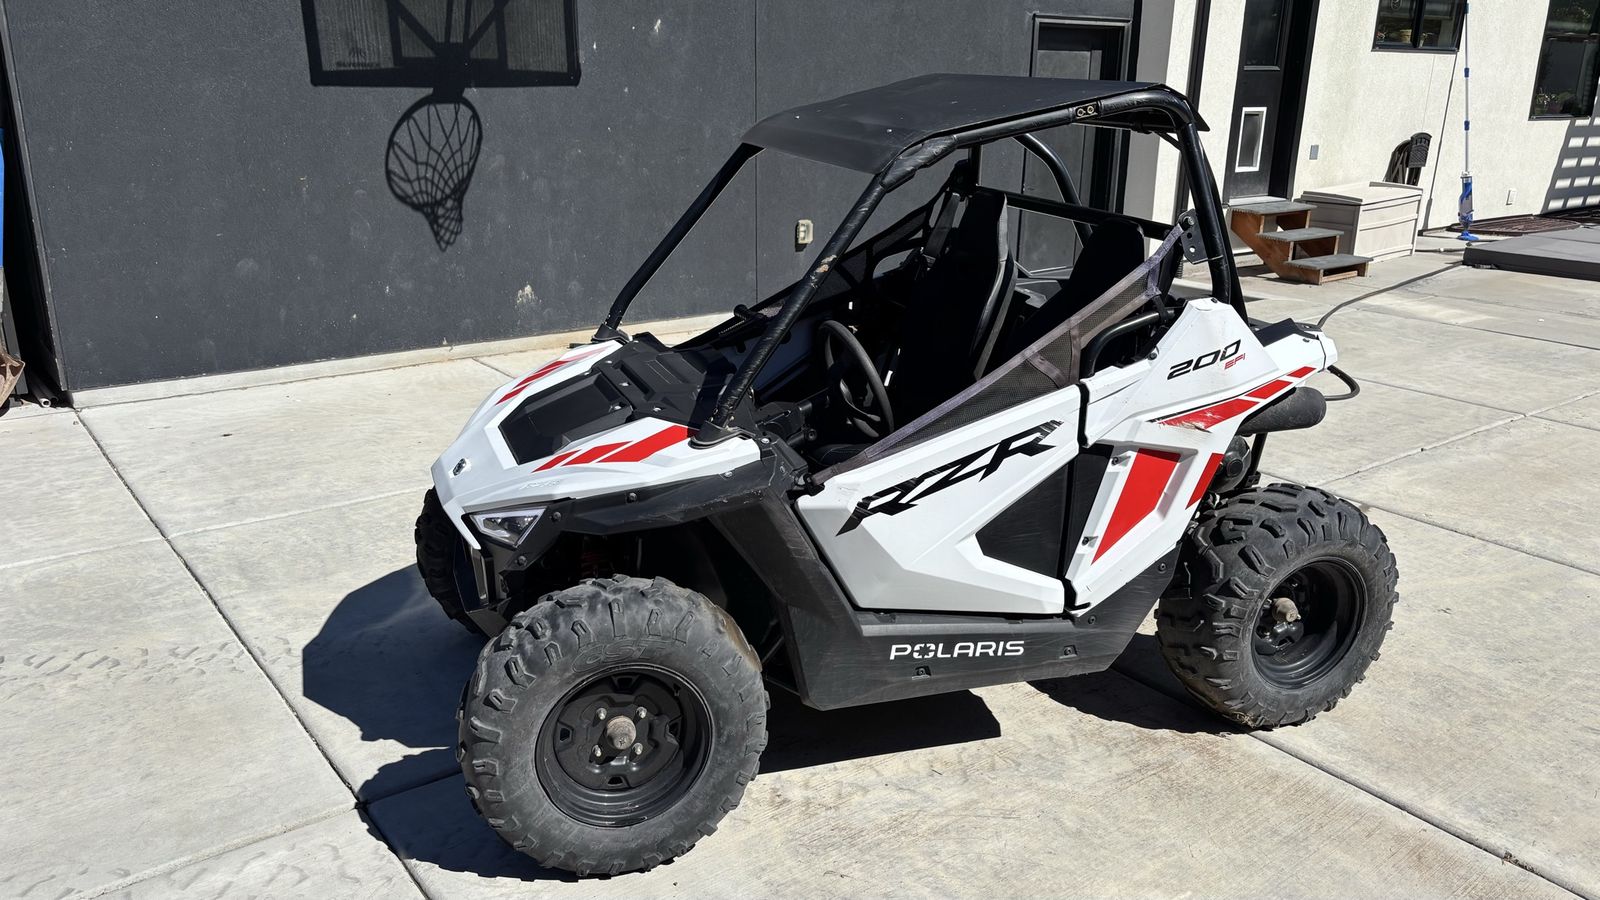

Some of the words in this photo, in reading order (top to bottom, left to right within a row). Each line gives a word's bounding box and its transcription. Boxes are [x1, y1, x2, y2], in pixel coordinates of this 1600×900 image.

[1167, 339, 1241, 380] 200
[1224, 353, 1246, 370] EFI
[837, 420, 1063, 536] RZR
[890, 641, 1025, 661] POLARIS
